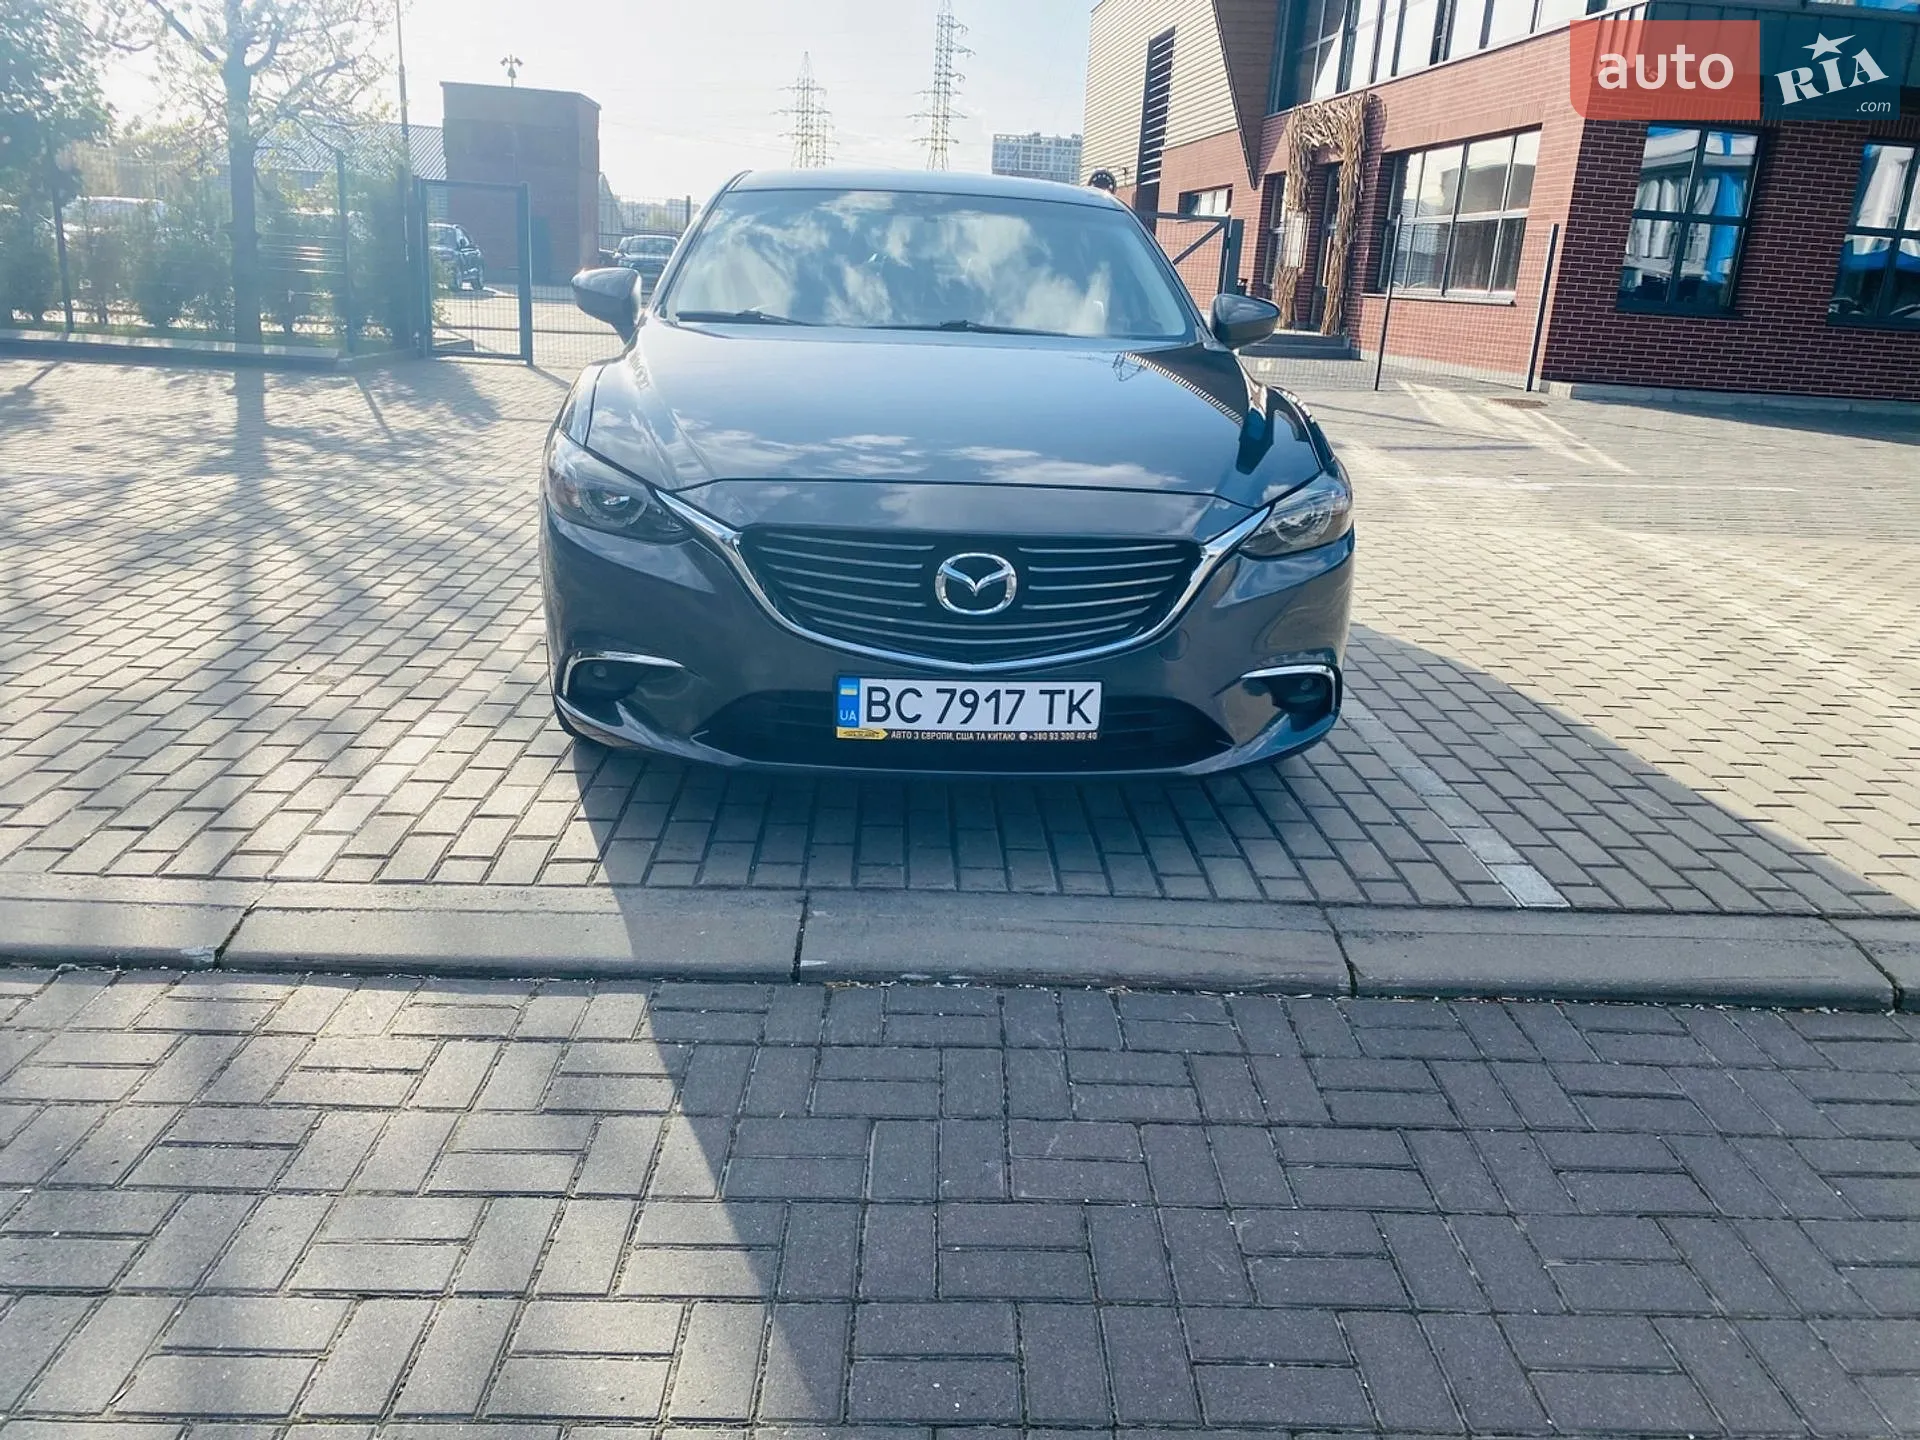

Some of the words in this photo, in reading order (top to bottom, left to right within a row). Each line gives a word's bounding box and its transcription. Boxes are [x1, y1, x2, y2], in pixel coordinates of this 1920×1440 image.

[866, 686, 922, 724] BC
[936, 688, 1026, 725] 7917
[1039, 688, 1094, 725] TK
[839, 710, 857, 721] UA
[891, 730, 912, 740] АВТО
[956, 732, 974, 741] США
[976, 732, 986, 741] ТА
